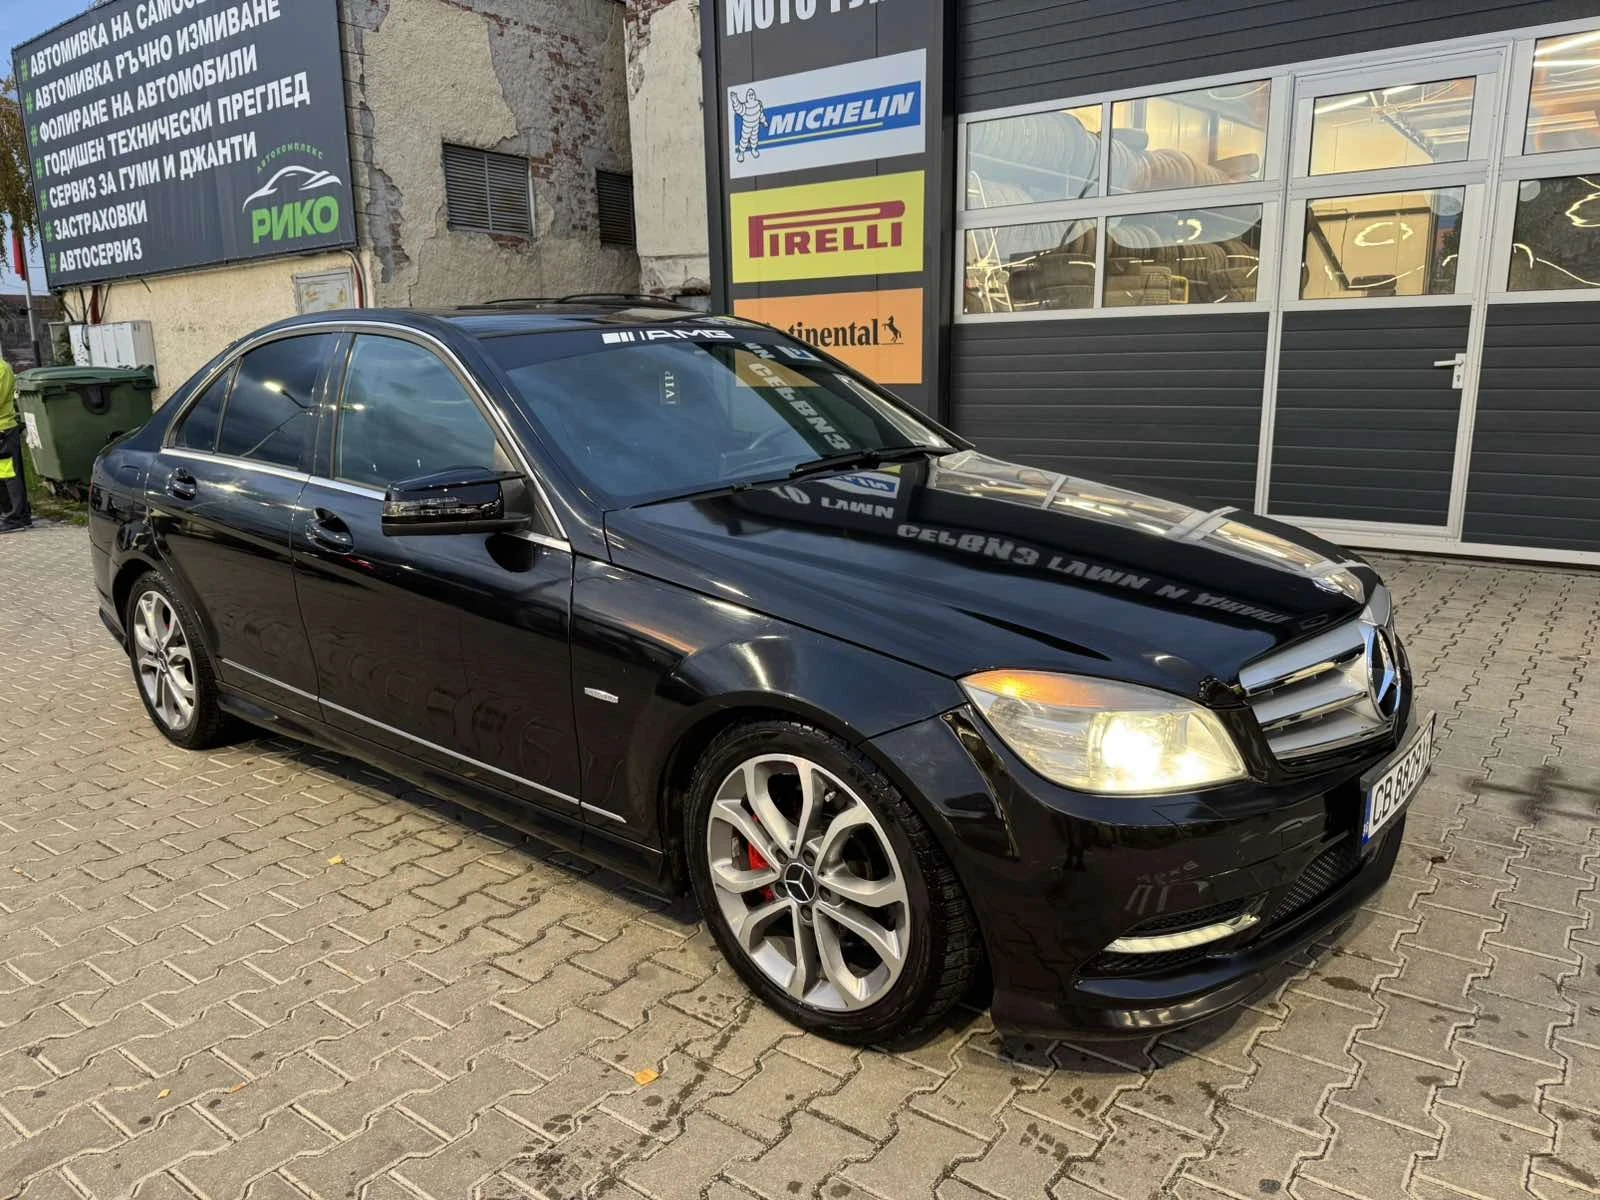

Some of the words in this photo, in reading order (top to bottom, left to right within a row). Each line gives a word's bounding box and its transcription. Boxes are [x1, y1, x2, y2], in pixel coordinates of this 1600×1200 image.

[30, 22, 109, 77] АВТОМИВКА
[111, 10, 134, 41] НА
[35, 60, 114, 111] АВТОМИВКА
[115, 34, 173, 79] РЪЧНО
[176, 0, 281, 55] ИЗМИВАНЕ
[40, 98, 109, 143] ФОЛИРАНЕ
[111, 90, 135, 119] НА
[137, 44, 258, 111] АВТОМОБИЛИ
[768, 91, 915, 136] MICHELIN
[44, 136, 106, 176] ГОДИШЕН
[107, 101, 213, 157] ТЕХНИЧЕСКИ
[217, 71, 310, 124] ПРЕГЛЕД
[49, 176, 97, 208] СЕРВИЗ
[98, 171, 117, 196] ЗА
[119, 158, 161, 191] ГУМИ
[162, 153, 176, 179] И
[179, 131, 258, 181] ДЖАНТИ
[256, 142, 324, 174] АВТОКОМПЛЕКС
[53, 200, 148, 240] ЗАСТРАХОВКИ
[252, 195, 339, 244] РИКО
[748, 200, 906, 259] PIRELLI
[60, 237, 143, 272] АВТОСЕРВИЗ
